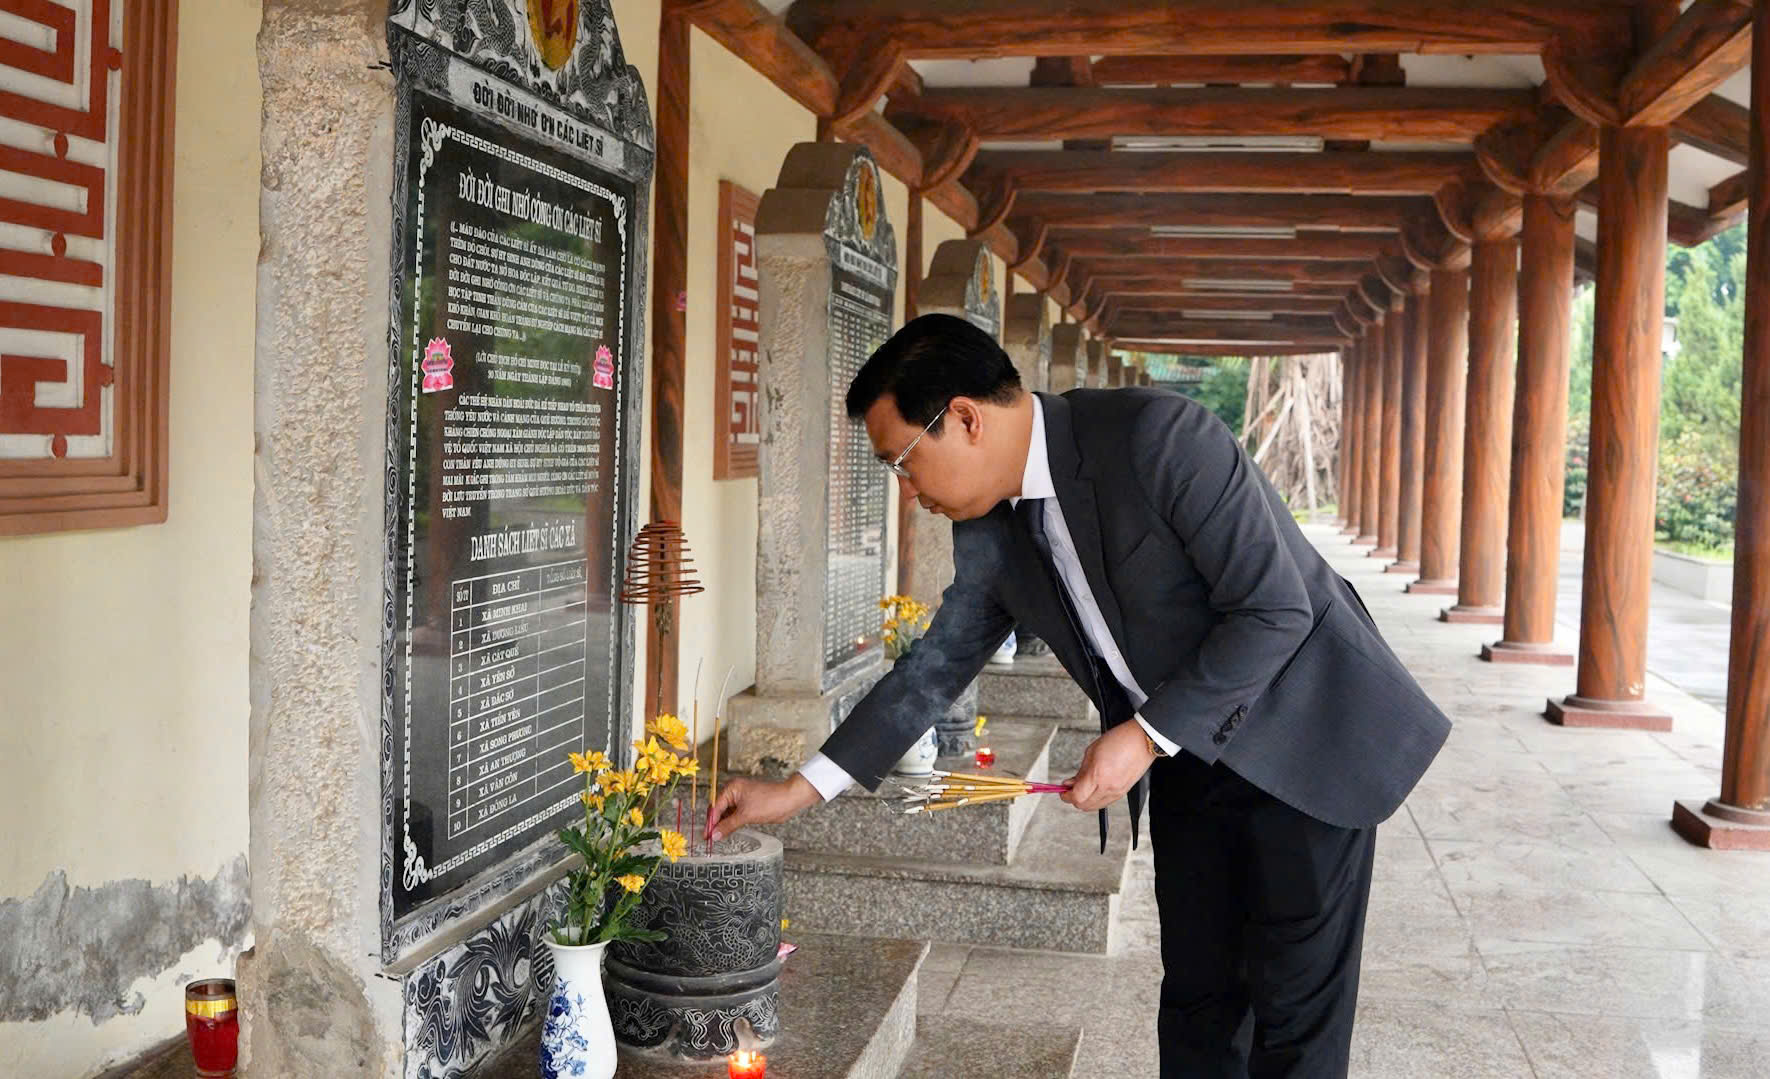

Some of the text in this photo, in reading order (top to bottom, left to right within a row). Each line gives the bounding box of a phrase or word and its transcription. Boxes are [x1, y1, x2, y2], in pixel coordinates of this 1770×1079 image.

[473, 79, 493, 109] ĐỜI
[497, 88, 515, 118] ĐỜI
[517, 103, 538, 128] NHỚ
[541, 112, 555, 136] ƠN
[557, 118, 574, 145] CÁC
[459, 166, 477, 202] ĐỜI
[477, 172, 494, 208] ĐỜI
[495, 185, 511, 214] GHI
[511, 188, 530, 220] NHỚ
[530, 191, 551, 227] CÔNG
[552, 203, 564, 230] ƠN
[564, 203, 578, 235] CÁC
[471, 516, 576, 561] DANH SÁCH LIỆT SĨ CÁC XÃ
[492, 575, 520, 597] ĐỊA CHỈ
[458, 618, 463, 627] 1
[458, 640, 463, 650] 2
[458, 663, 463, 673] 3
[458, 686, 463, 695] 4
[457, 708, 462, 718] 5
[456, 731, 462, 740] 6
[456, 754, 461, 763] 7
[456, 776, 461, 785] 8
[455, 798, 461, 808] 9
[453, 821, 461, 832] 10
